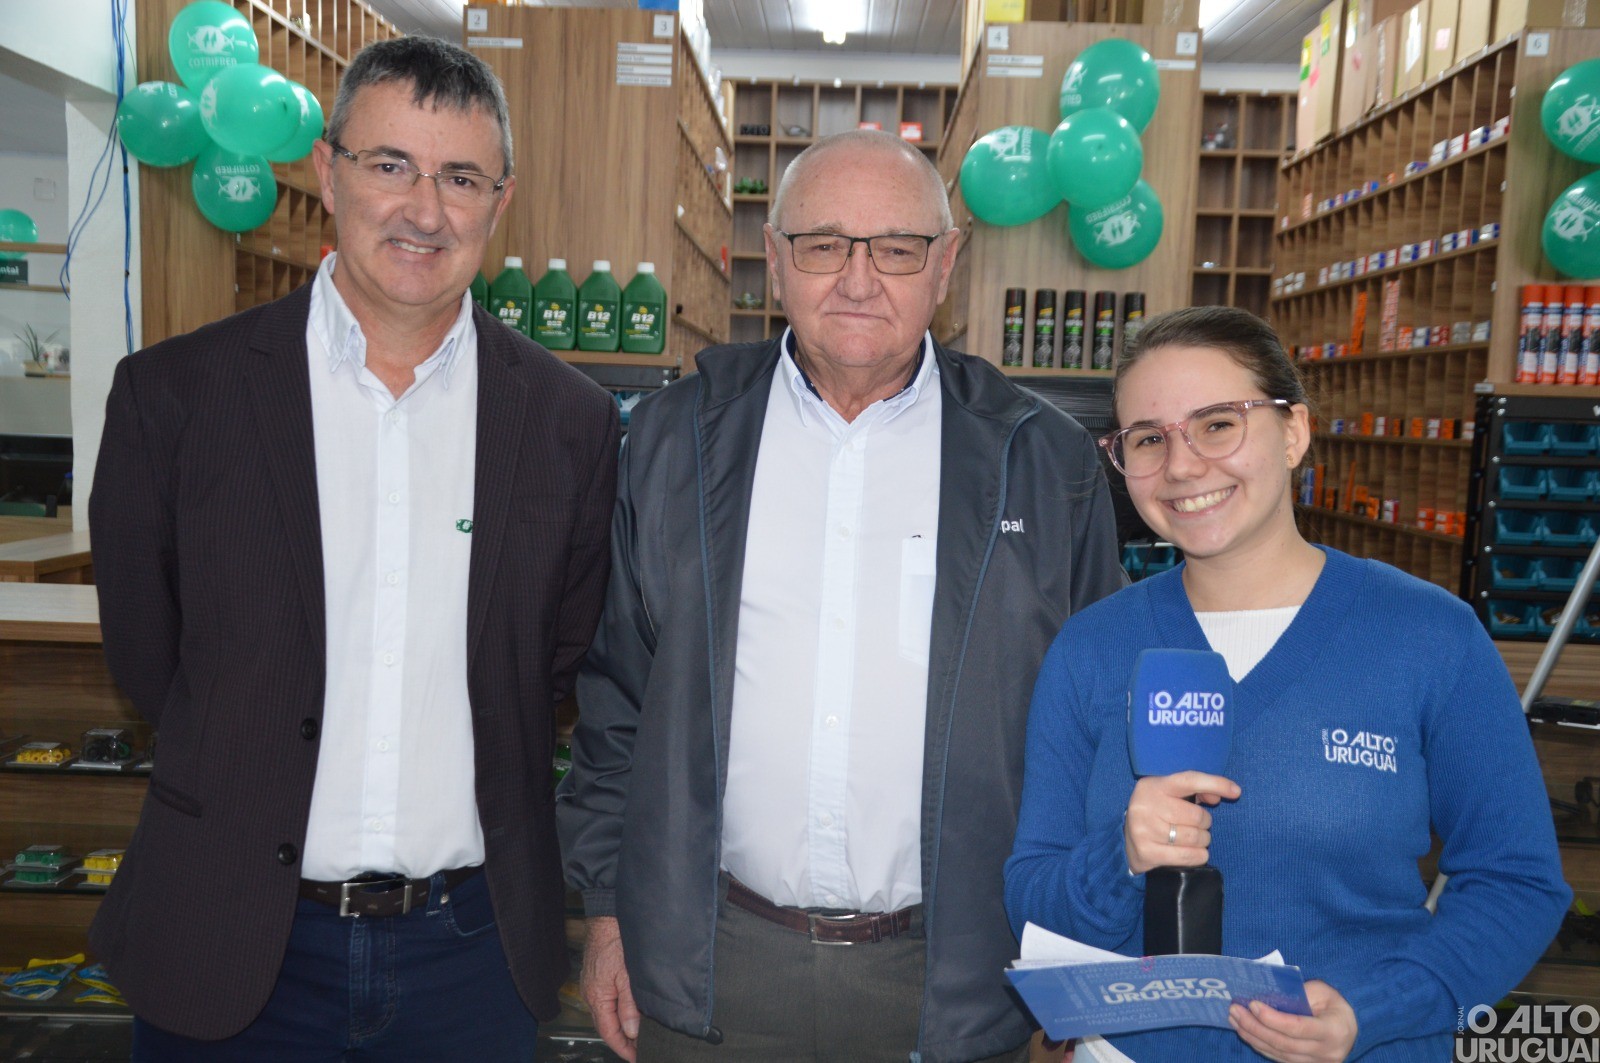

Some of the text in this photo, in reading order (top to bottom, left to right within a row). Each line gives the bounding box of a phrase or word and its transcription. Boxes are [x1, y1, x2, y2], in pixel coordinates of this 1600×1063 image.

[473, 14, 481, 25] 2
[661, 21, 668, 31] 3
[994, 31, 1001, 42] 4
[1183, 38, 1191, 49] 5
[1534, 37, 1542, 49] 6
[499, 307, 522, 319] B12
[543, 309, 567, 321] B12
[587, 310, 611, 322] B12
[631, 312, 655, 324] B12
[1000, 518, 1025, 533] pal
[1154, 690, 1173, 709] O
[1174, 692, 1225, 710] ALTO
[1148, 709, 1224, 726] URUGUAI
[1331, 728, 1348, 745] O
[1349, 731, 1395, 754] ALTO
[1324, 744, 1397, 774] URUGUAI
[1107, 982, 1136, 993] O
[1140, 977, 1227, 992] ALTO
[1102, 988, 1233, 1005] URUGUAI
